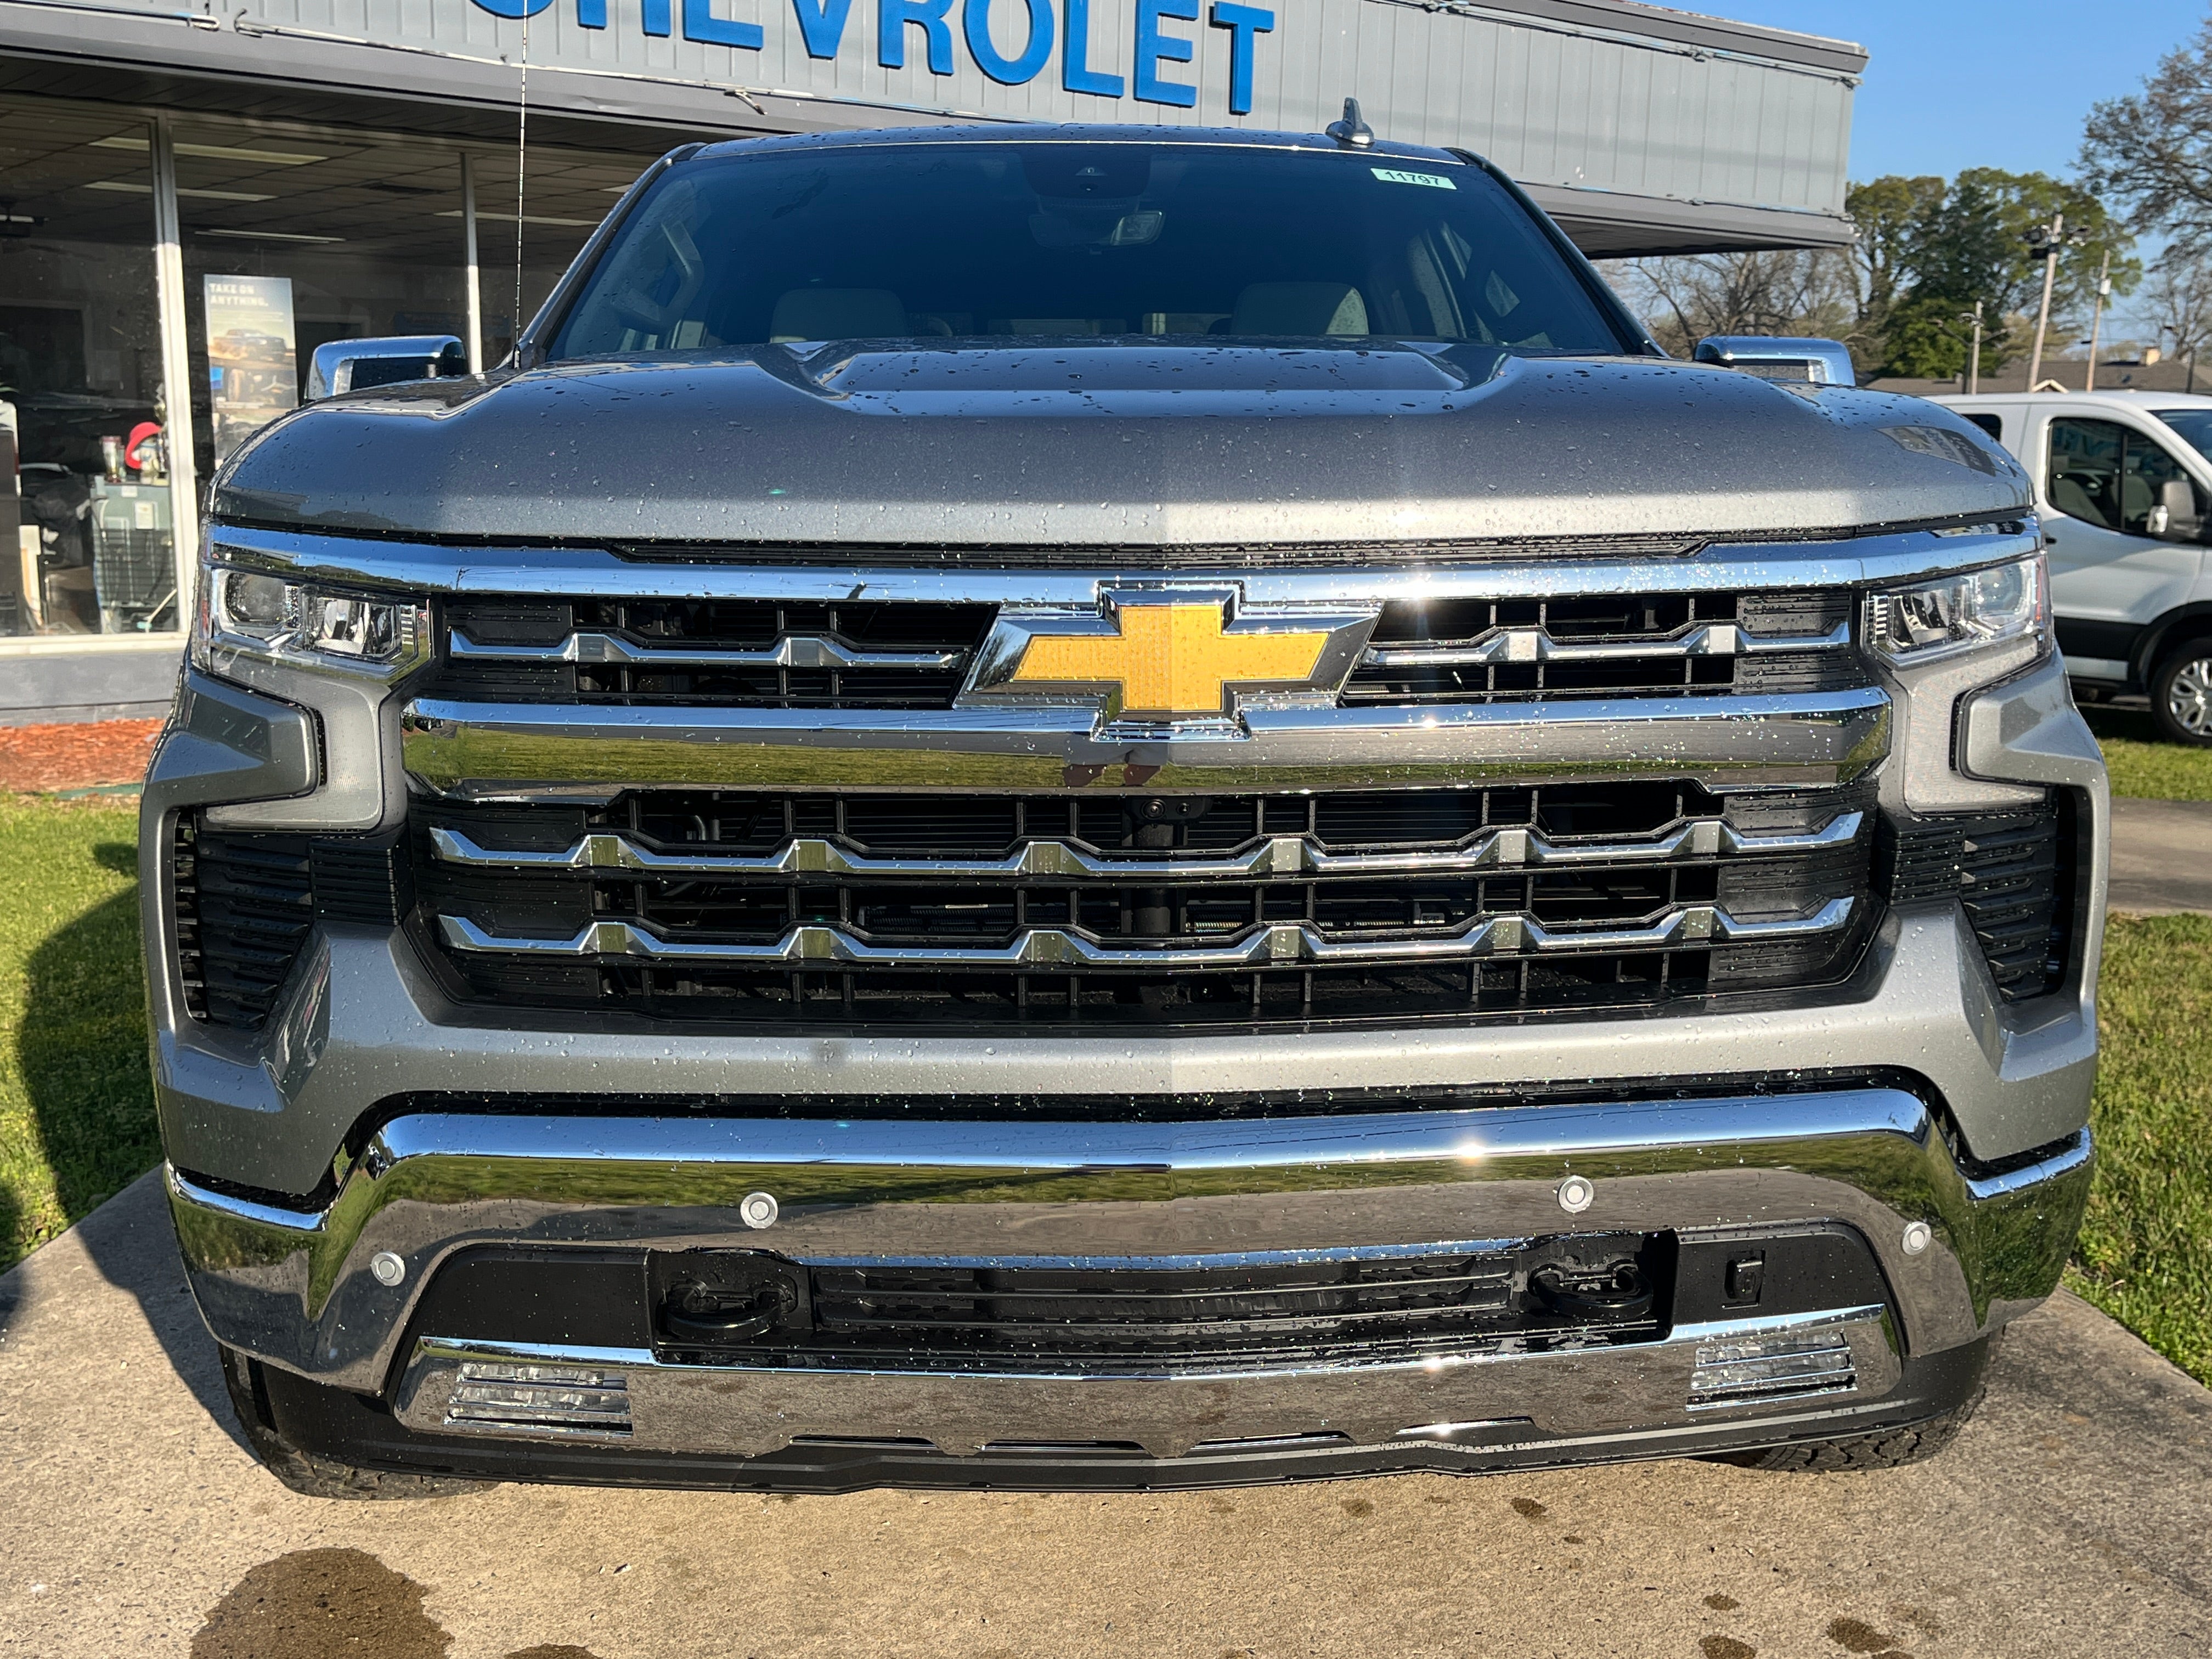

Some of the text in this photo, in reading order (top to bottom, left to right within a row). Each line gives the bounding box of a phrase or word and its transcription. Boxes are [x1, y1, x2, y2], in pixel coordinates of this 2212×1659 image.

[470, 0, 1274, 116] VROLET
[1385, 171, 1441, 185] 11797
[209, 283, 255, 295] TAKE ON
[210, 295, 269, 307] ANYTHING.
